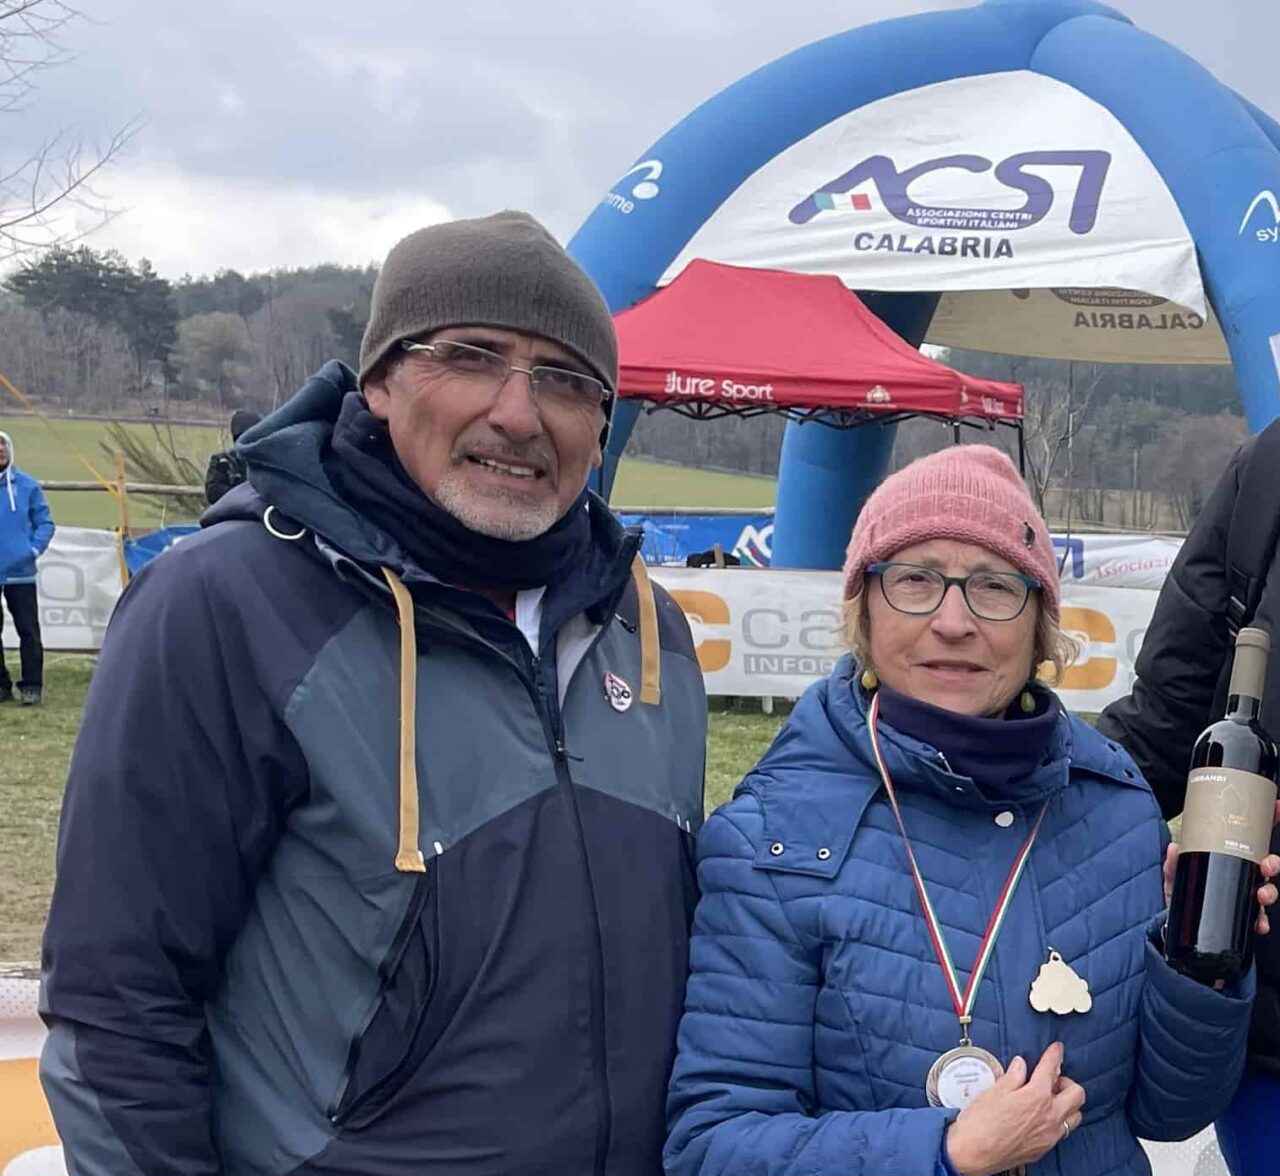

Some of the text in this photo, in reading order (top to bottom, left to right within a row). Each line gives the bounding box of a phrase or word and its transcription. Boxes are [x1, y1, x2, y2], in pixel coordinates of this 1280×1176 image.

[788, 150, 1112, 234] ACSI
[906, 207, 1033, 220] ASSOCIAZIONE CENTRI
[917, 218, 1018, 229] SPORTIVI ITALIANI
[853, 232, 1014, 259] CALABRIA
[721, 379, 774, 400] Sport
[1092, 554, 1173, 580] Associazi
